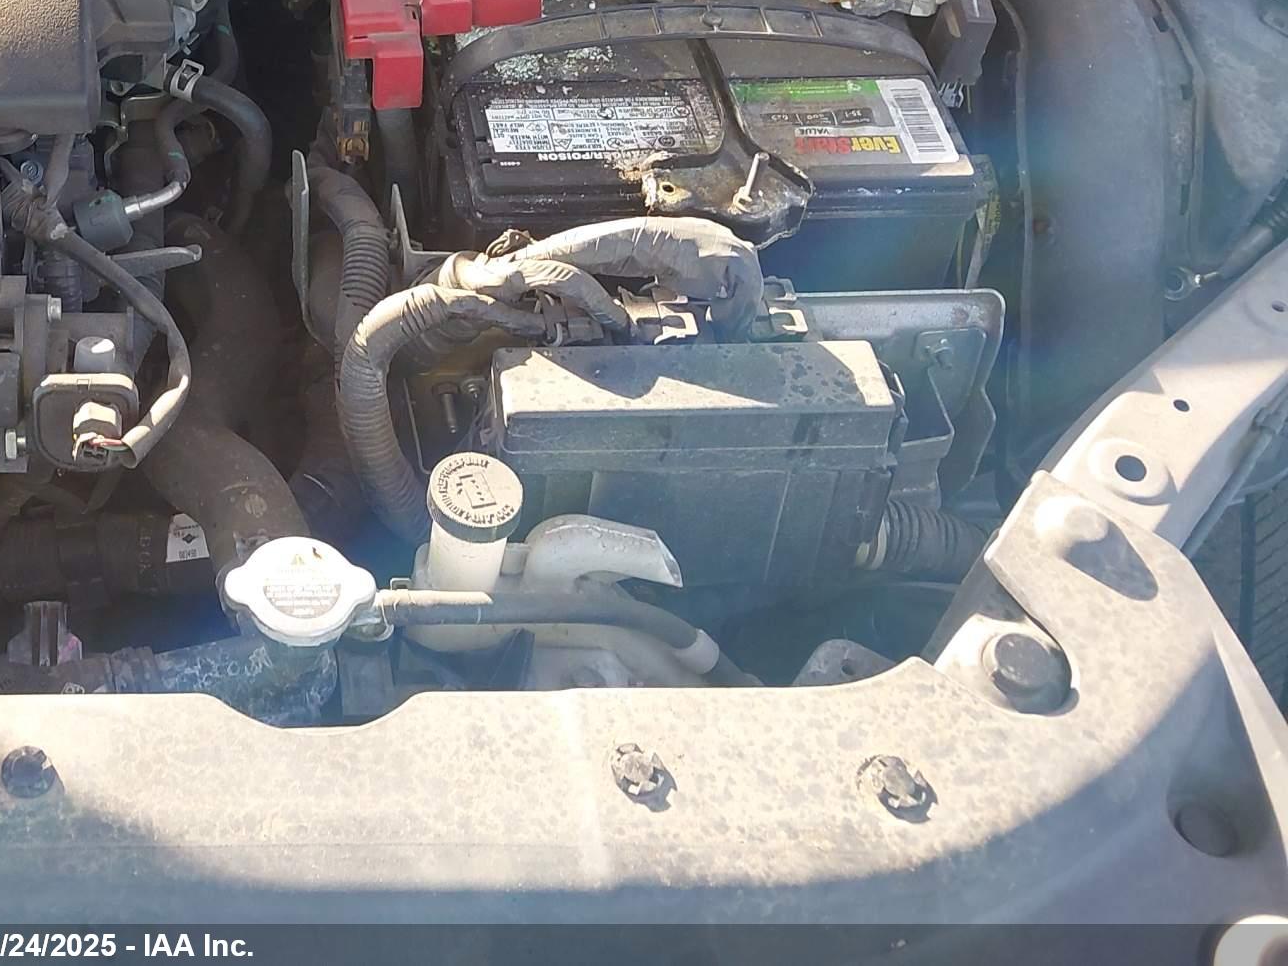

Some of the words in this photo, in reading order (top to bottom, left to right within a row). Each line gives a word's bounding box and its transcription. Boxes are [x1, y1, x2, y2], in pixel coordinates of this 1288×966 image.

[798, 127, 829, 136] VALUE
[794, 135, 901, 154] EverStart
[537, 150, 650, 162] ANGER/POISON
